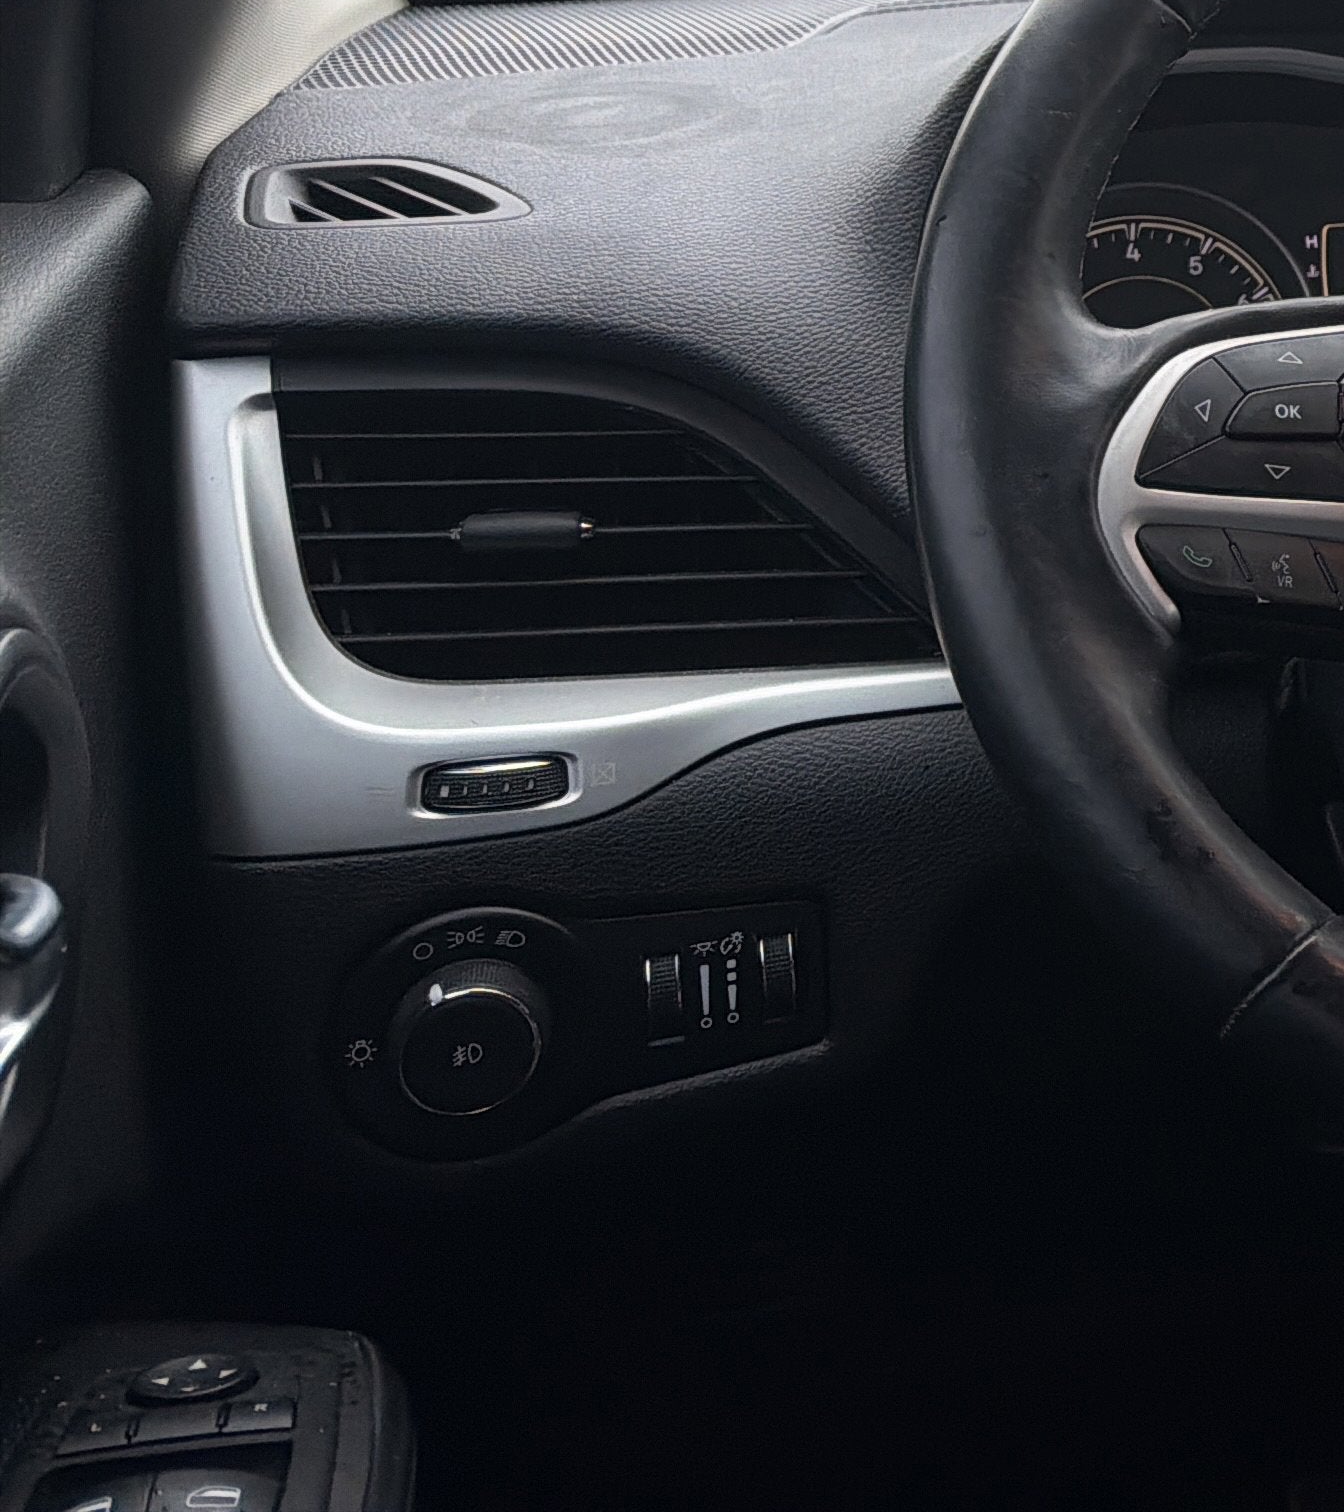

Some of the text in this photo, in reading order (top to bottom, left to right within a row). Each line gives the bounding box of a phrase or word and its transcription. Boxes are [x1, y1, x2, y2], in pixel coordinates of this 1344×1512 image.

[1305, 235, 1319, 249] H
[1126, 242, 1142, 262] 4
[1189, 255, 1204, 276] 5
[1274, 403, 1302, 420] OK
[1277, 575, 1294, 588] VR
